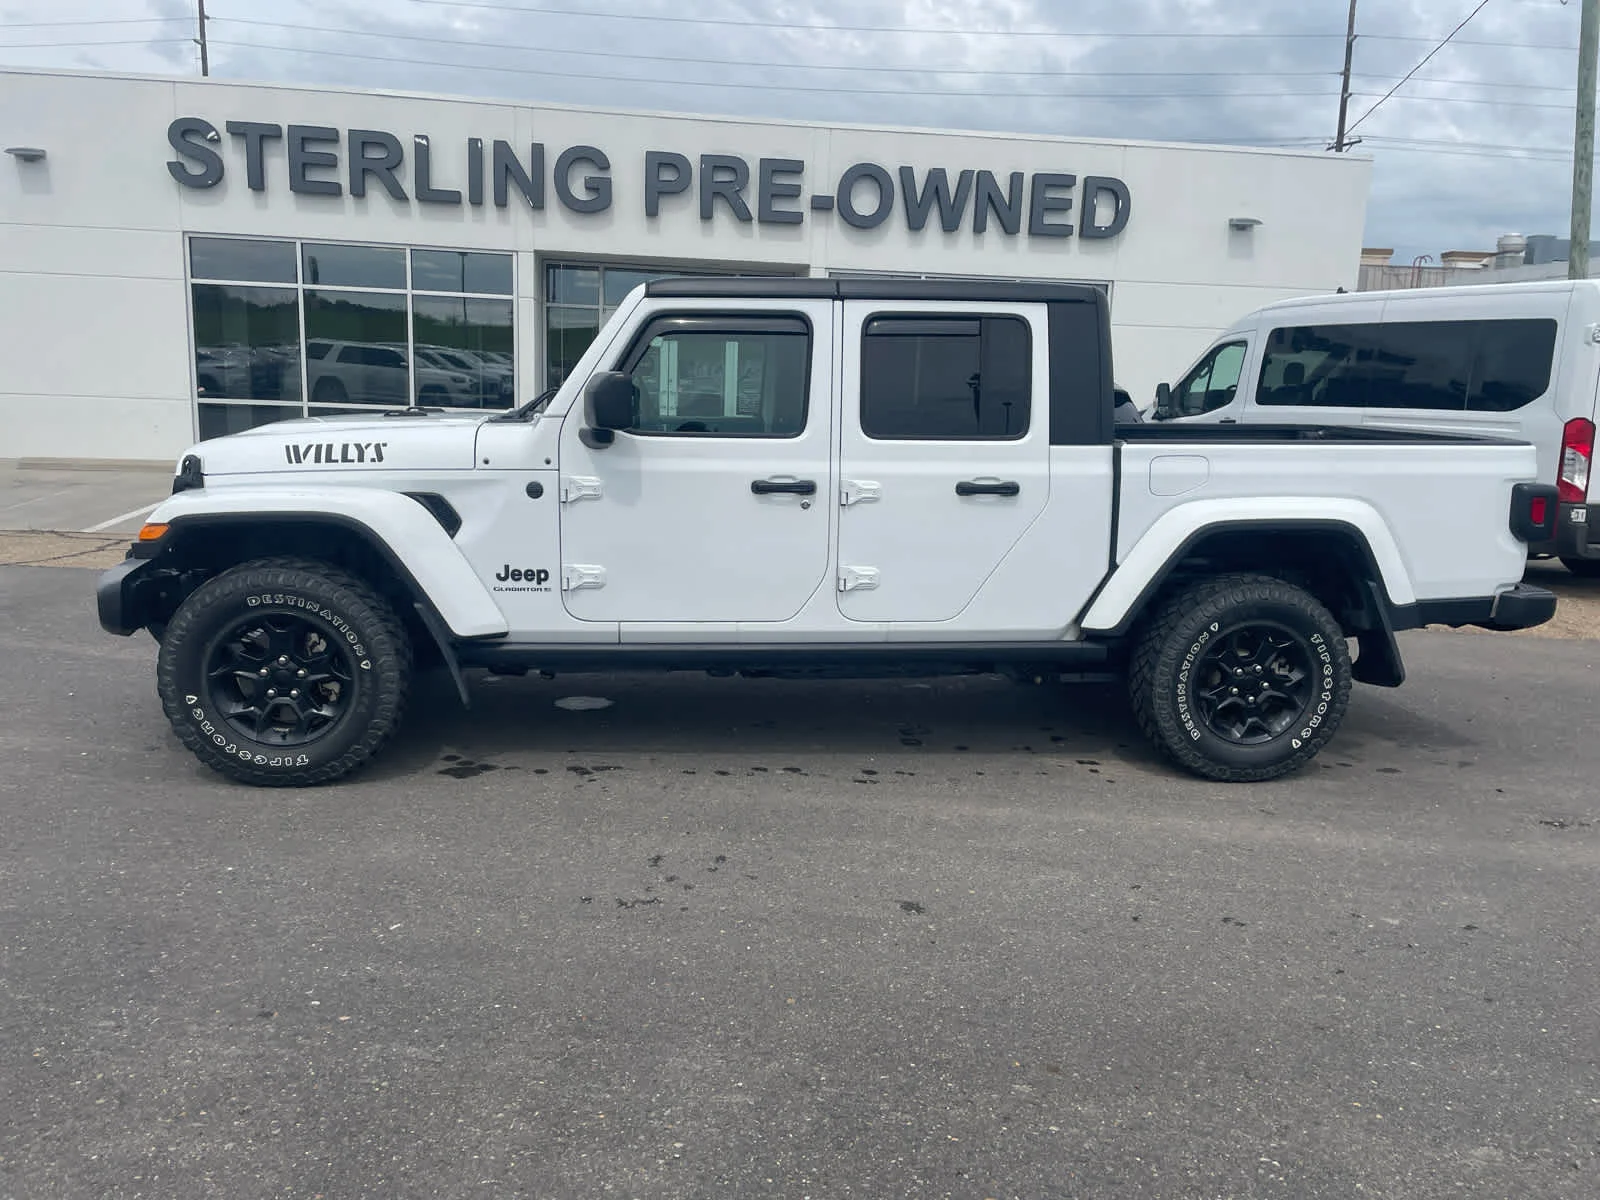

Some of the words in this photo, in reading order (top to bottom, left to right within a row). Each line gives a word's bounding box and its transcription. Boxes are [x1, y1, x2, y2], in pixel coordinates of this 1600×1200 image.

[166, 117, 613, 214] STERLING
[645, 150, 1132, 239] PRE-OWNED
[285, 442, 388, 464] WILLYS
[495, 564, 549, 585] Jeep
[247, 595, 364, 656] DESTINATION
[1178, 632, 1209, 740] DESTINATION
